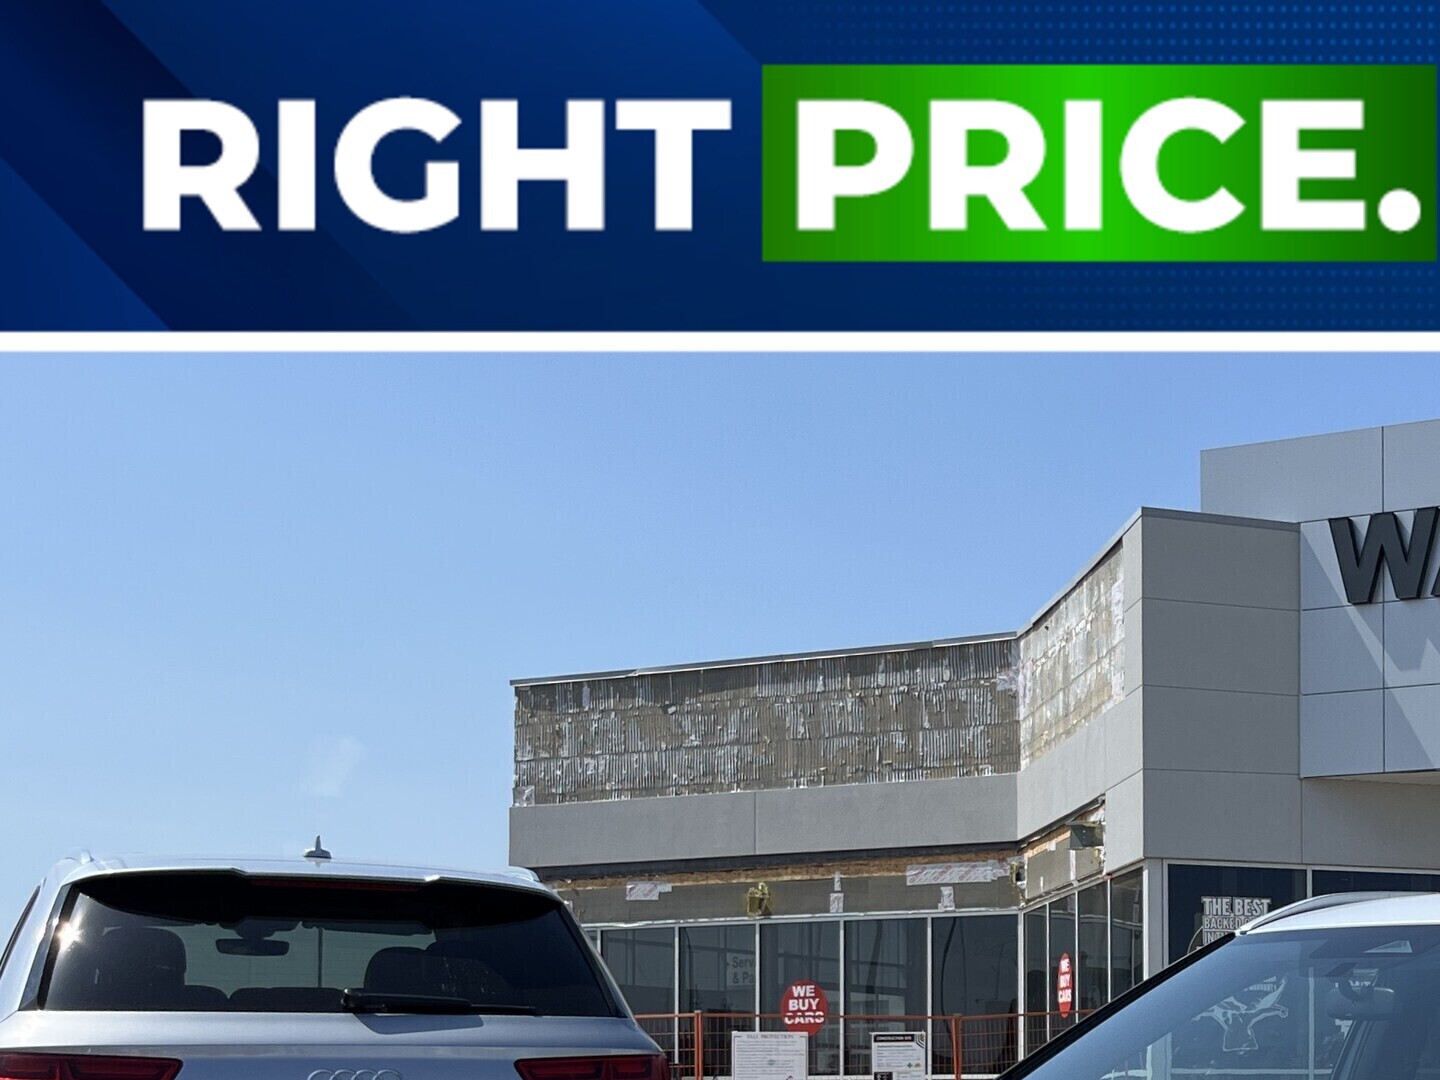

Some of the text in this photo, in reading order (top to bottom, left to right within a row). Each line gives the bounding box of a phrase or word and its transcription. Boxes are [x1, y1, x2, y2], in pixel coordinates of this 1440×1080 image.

[1201, 896, 1271, 916] THE BEST
[792, 985, 815, 997] WE
[788, 998, 820, 1011] BUY
[784, 1011, 825, 1025] CARS
